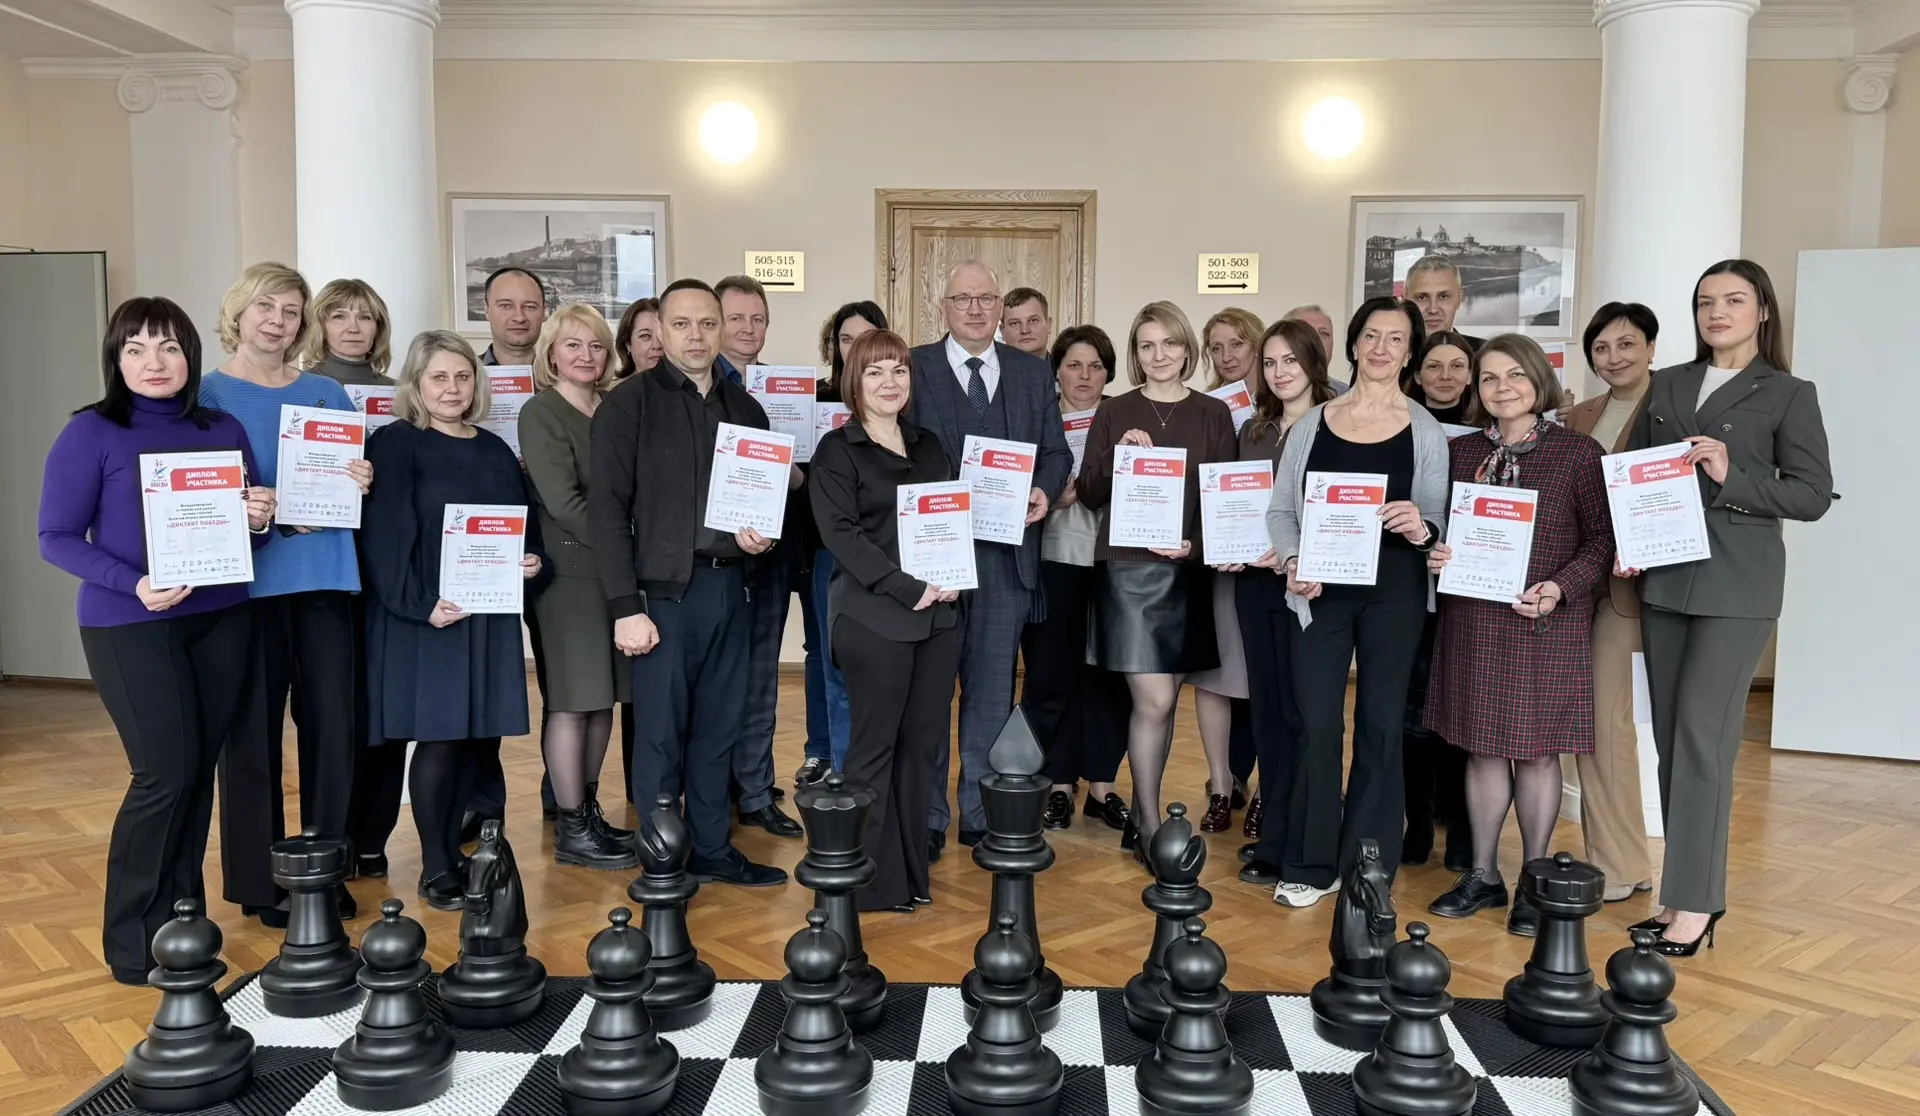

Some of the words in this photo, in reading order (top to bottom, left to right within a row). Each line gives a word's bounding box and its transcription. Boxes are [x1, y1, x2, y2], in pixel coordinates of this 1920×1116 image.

[754, 255, 795, 265] 505-515
[1208, 257, 1249, 267] 501-503
[754, 268, 794, 277] 516-521
[1208, 270, 1249, 280] 522-526
[316, 424, 344, 433] ДИПЛОМ
[316, 432, 352, 441] УЧАСТНИКА
[748, 443, 774, 452] ДИПЛОМ
[748, 450, 780, 460] УЧАСТНИКА
[992, 460, 1022, 469] УЧАСТНИКА
[1642, 462, 1671, 473] ДИПЛОМ
[186, 471, 218, 479] ДИПЛОМ
[1643, 469, 1681, 479] УЧАСТНИКА
[186, 478, 228, 487] УЧАСТНИКА
[1486, 502, 1514, 510] ДИПЛОМ
[1486, 508, 1521, 518] УЧАСТНИКА
